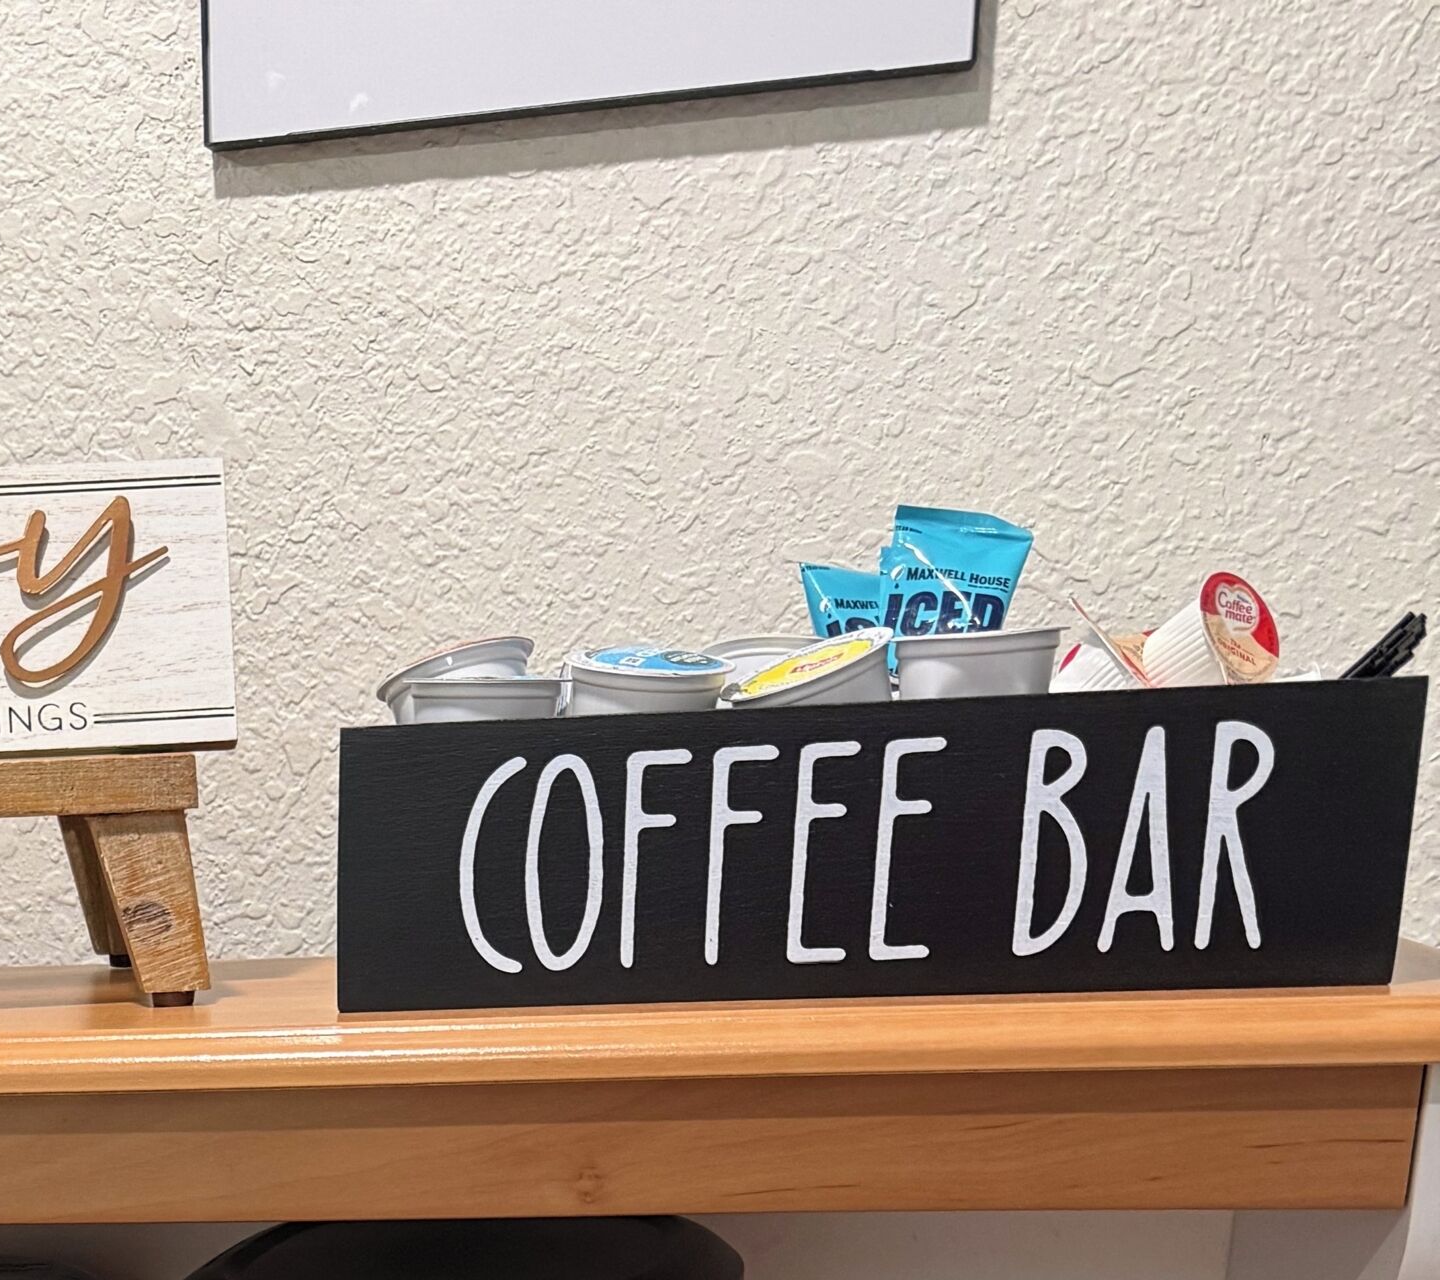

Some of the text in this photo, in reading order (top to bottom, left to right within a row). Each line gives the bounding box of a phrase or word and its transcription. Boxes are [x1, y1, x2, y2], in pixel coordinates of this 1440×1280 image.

[906, 567, 1011, 588] MAXWELL HOUSE
[834, 598, 879, 610] MAXWE
[884, 590, 1004, 637] ICED
[1218, 590, 1253, 615] Coffee
[1224, 610, 1253, 625] mate
[459, 721, 1275, 973] COFFEE BAR
